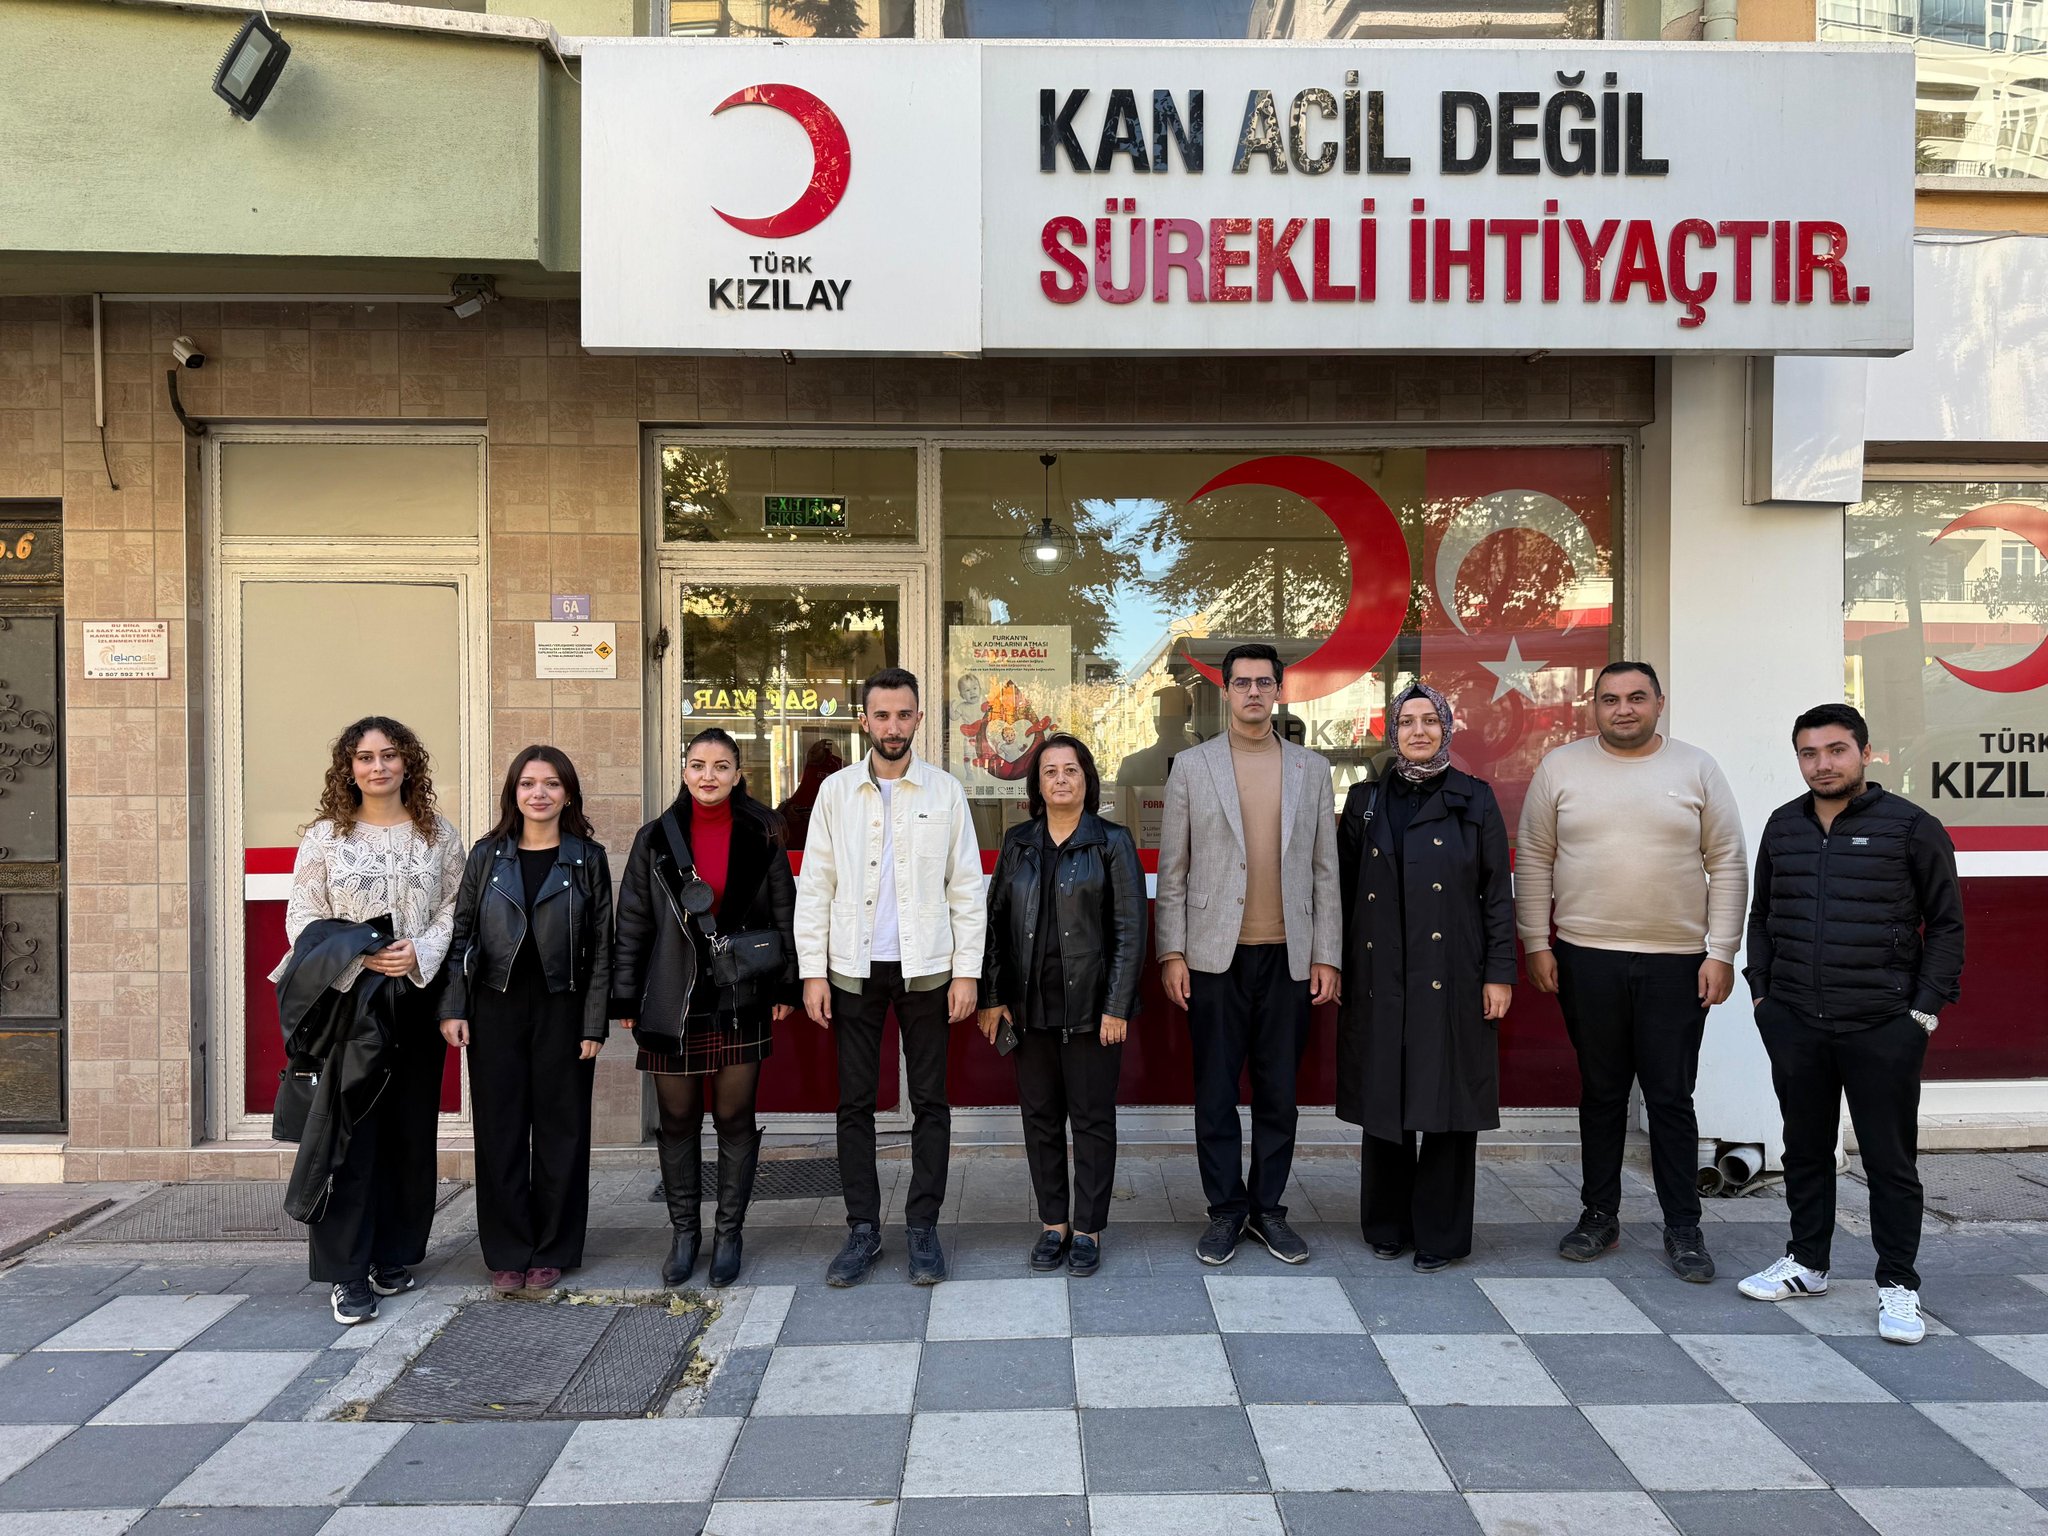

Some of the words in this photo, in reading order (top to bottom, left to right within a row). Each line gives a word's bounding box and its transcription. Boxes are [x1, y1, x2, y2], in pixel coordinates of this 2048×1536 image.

[1039, 88, 1204, 174] KAN
[1231, 69, 1411, 176] ACİL
[1439, 69, 1670, 177] DEĞİL
[748, 251, 813, 275] TÜRK
[1039, 197, 1378, 305] SÜREKLİ
[1409, 198, 1871, 329] İHTİYAÇTIR.
[708, 278, 852, 312] KIZILAY
[769, 497, 803, 511] EXIT
[562, 600, 580, 613] 6A
[974, 648, 1008, 658] SANA
[1010, 646, 1048, 658] BAĞLI
[1931, 761, 2048, 799] KIZIL
